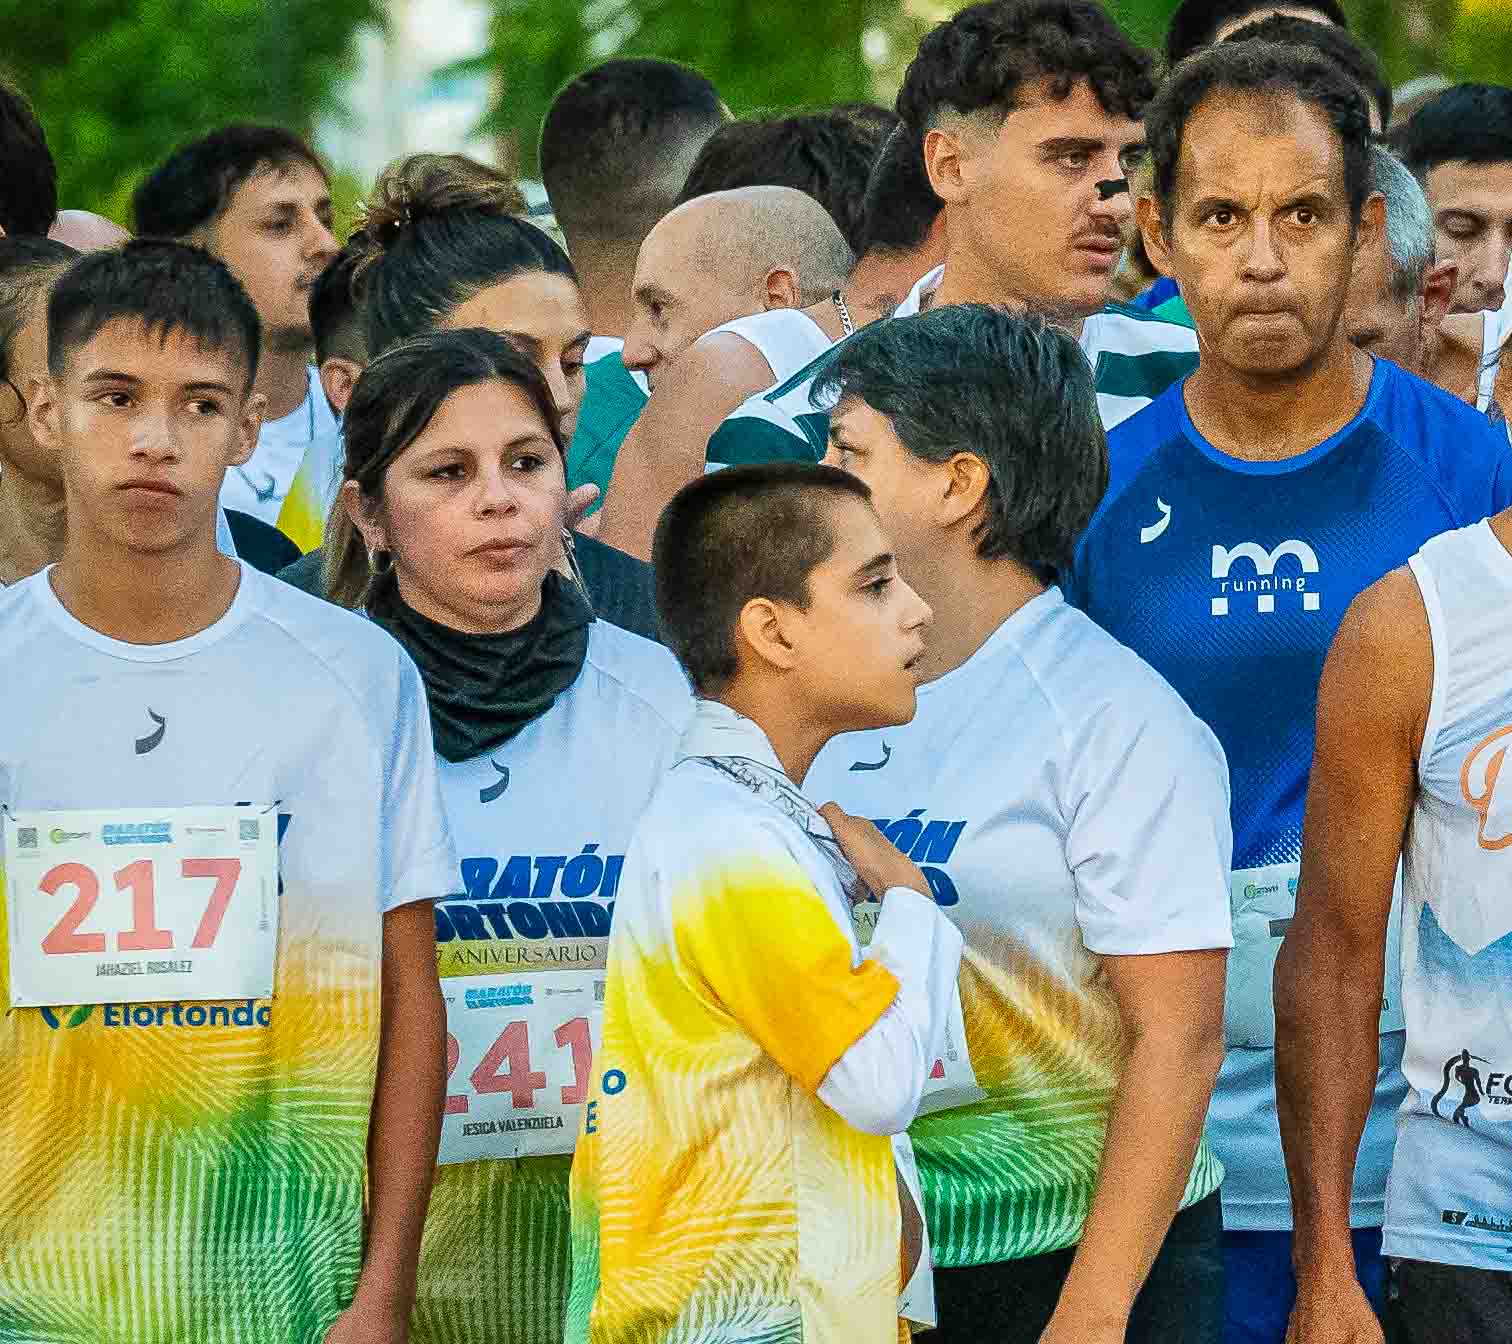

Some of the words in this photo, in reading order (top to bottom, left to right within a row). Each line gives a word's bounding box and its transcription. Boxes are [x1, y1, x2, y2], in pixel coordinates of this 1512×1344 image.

[1221, 576, 1306, 593] running
[38, 859, 241, 954] 217
[451, 945, 597, 965] ANIVERSARIO
[462, 1120, 497, 1136] JESICA
[499, 1116, 563, 1132] VALENZUELA
